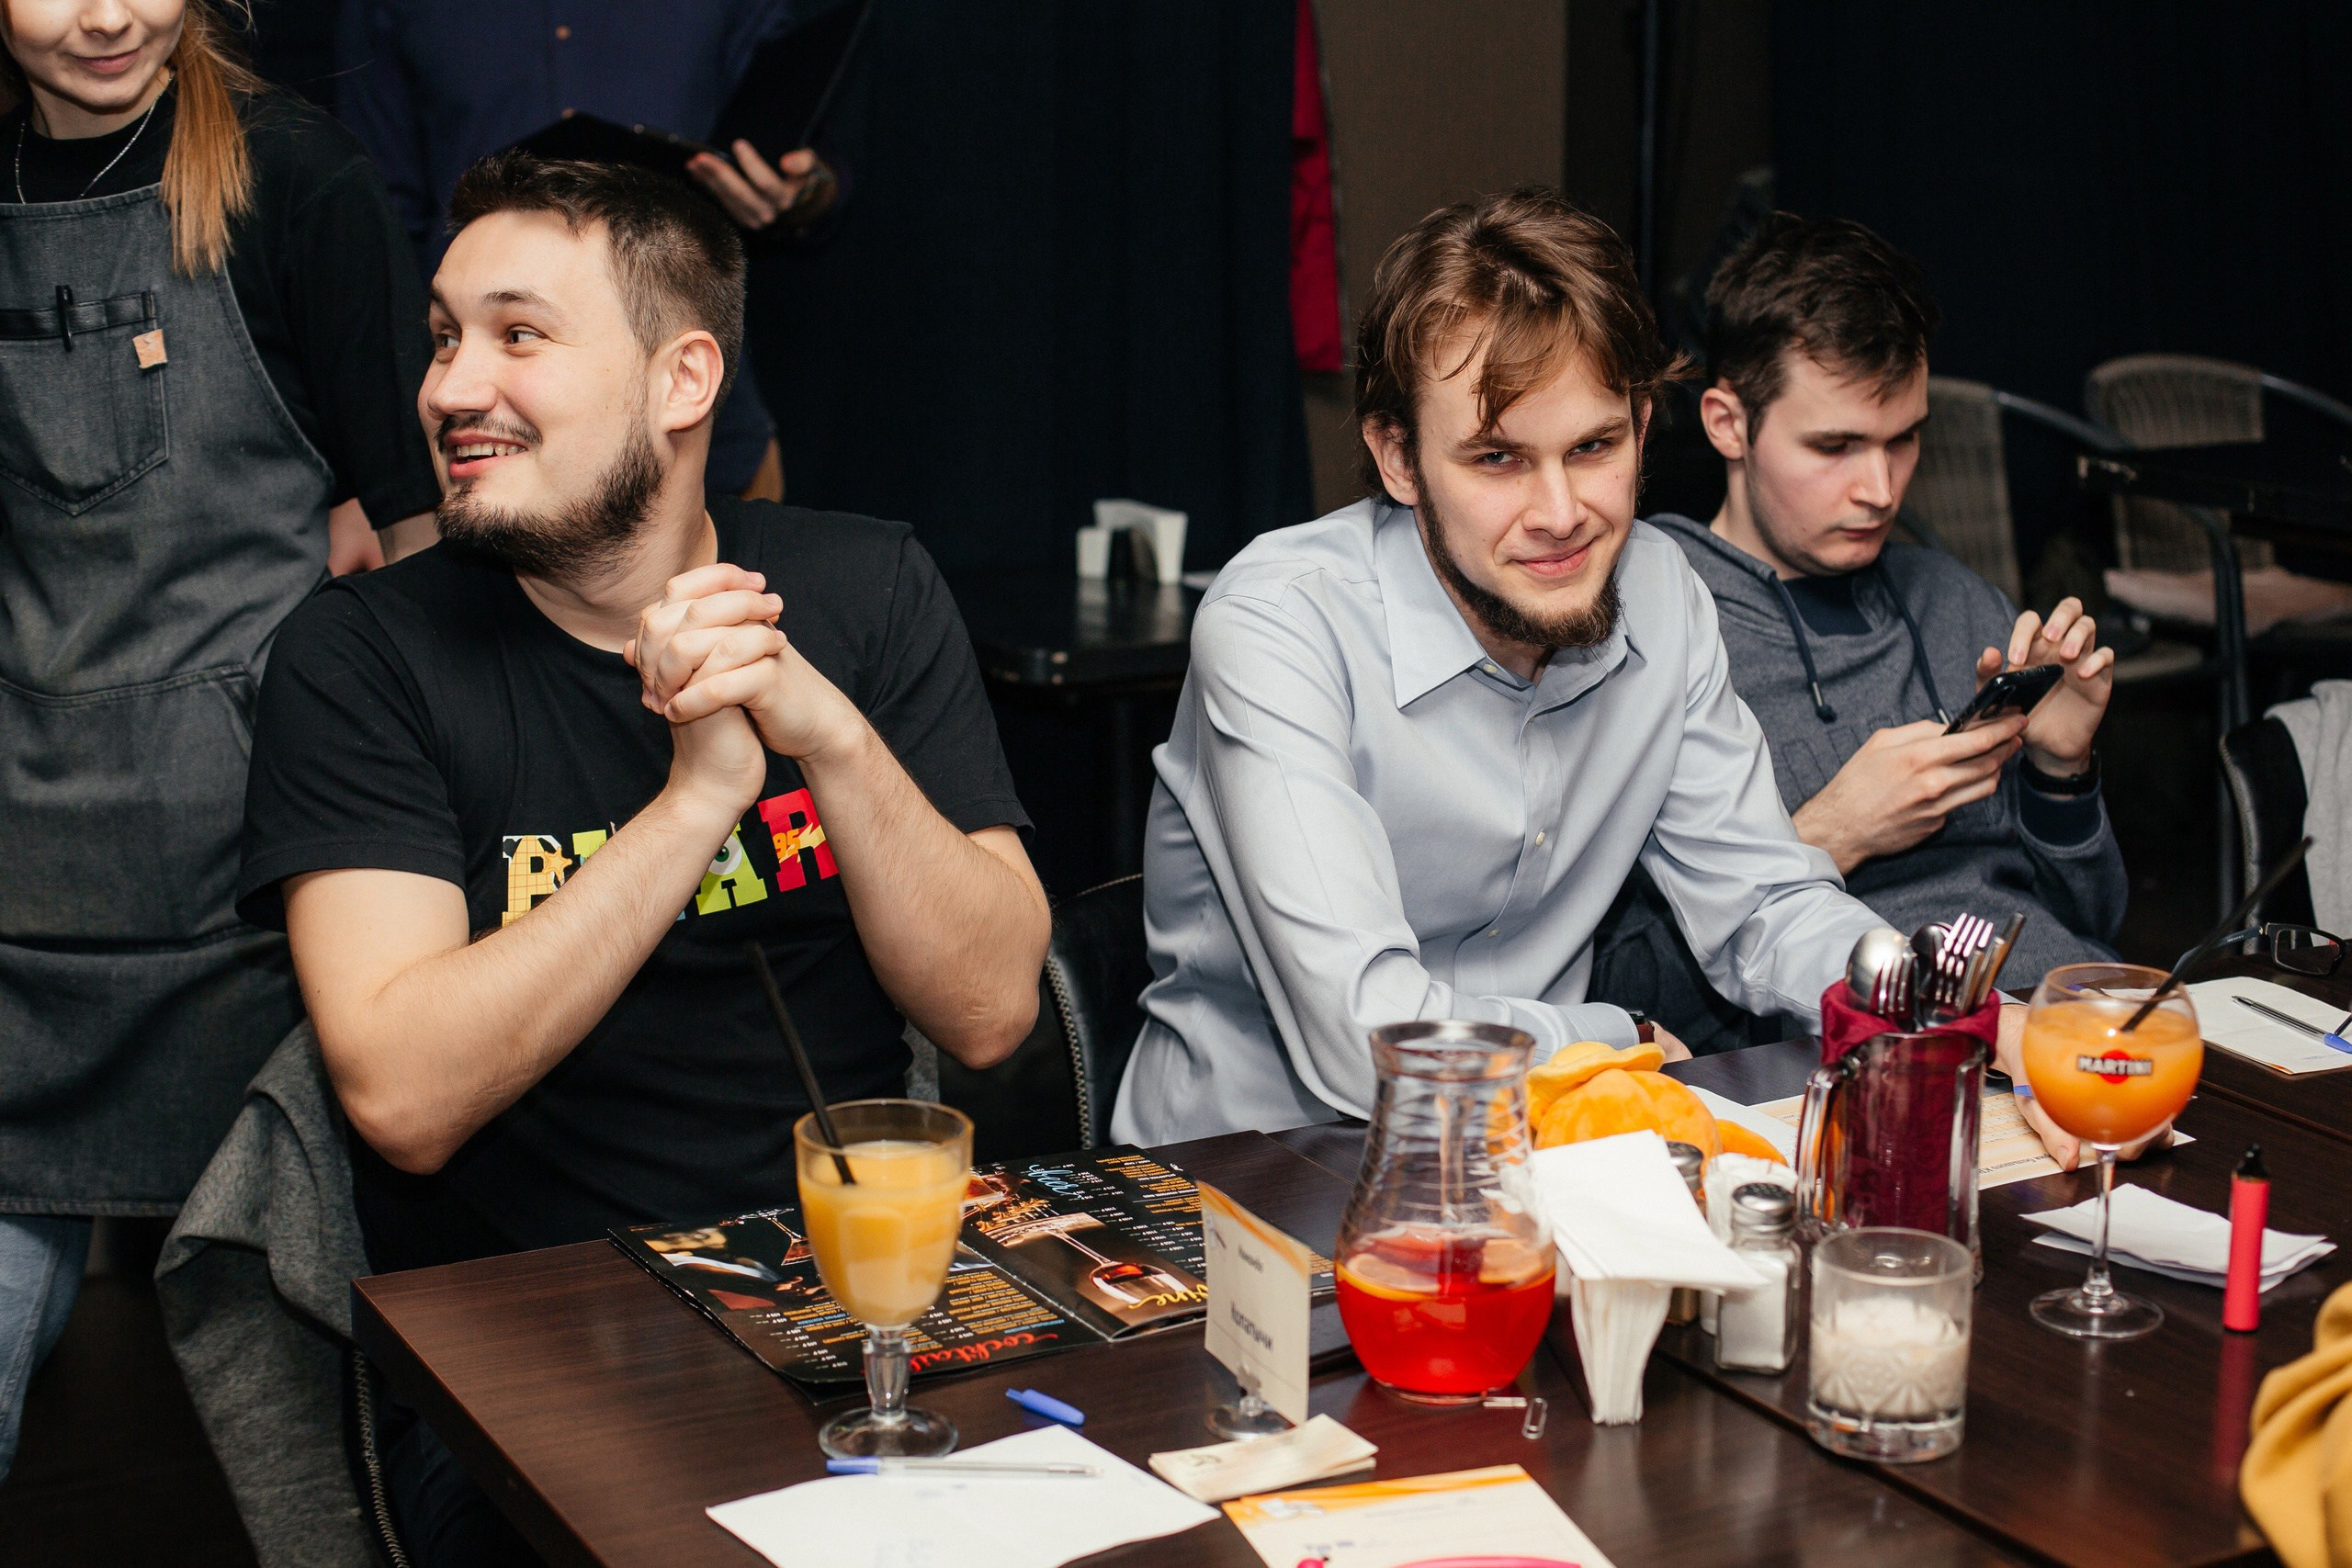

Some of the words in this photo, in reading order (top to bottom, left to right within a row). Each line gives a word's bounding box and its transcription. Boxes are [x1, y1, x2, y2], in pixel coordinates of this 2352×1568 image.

[503, 787, 840, 928] PAR
[773, 829, 800, 859] 95
[2077, 1055, 2153, 1076] MARTINI
